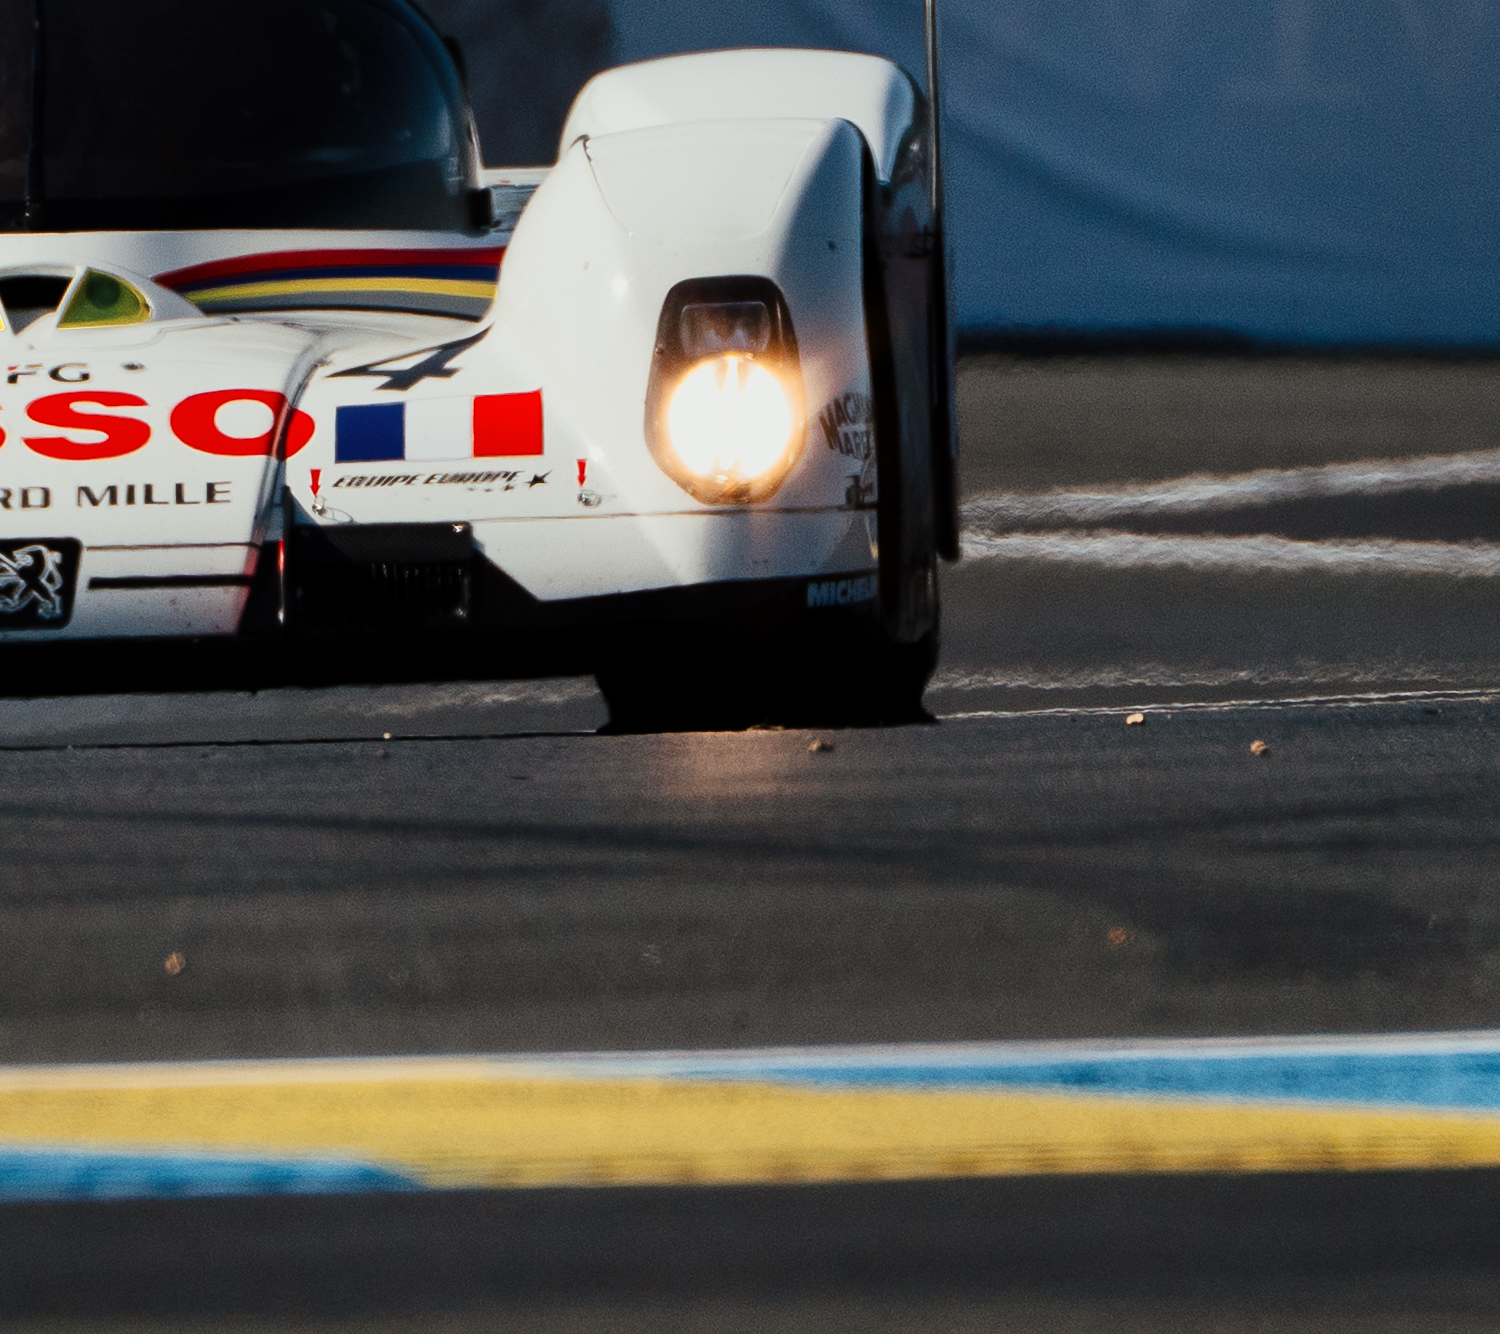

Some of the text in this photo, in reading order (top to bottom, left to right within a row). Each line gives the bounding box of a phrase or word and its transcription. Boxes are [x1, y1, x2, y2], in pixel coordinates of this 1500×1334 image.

[323, 320, 495, 392] 4
[332, 473, 424, 488] EQUIPE
[76, 481, 232, 508] MILLE
